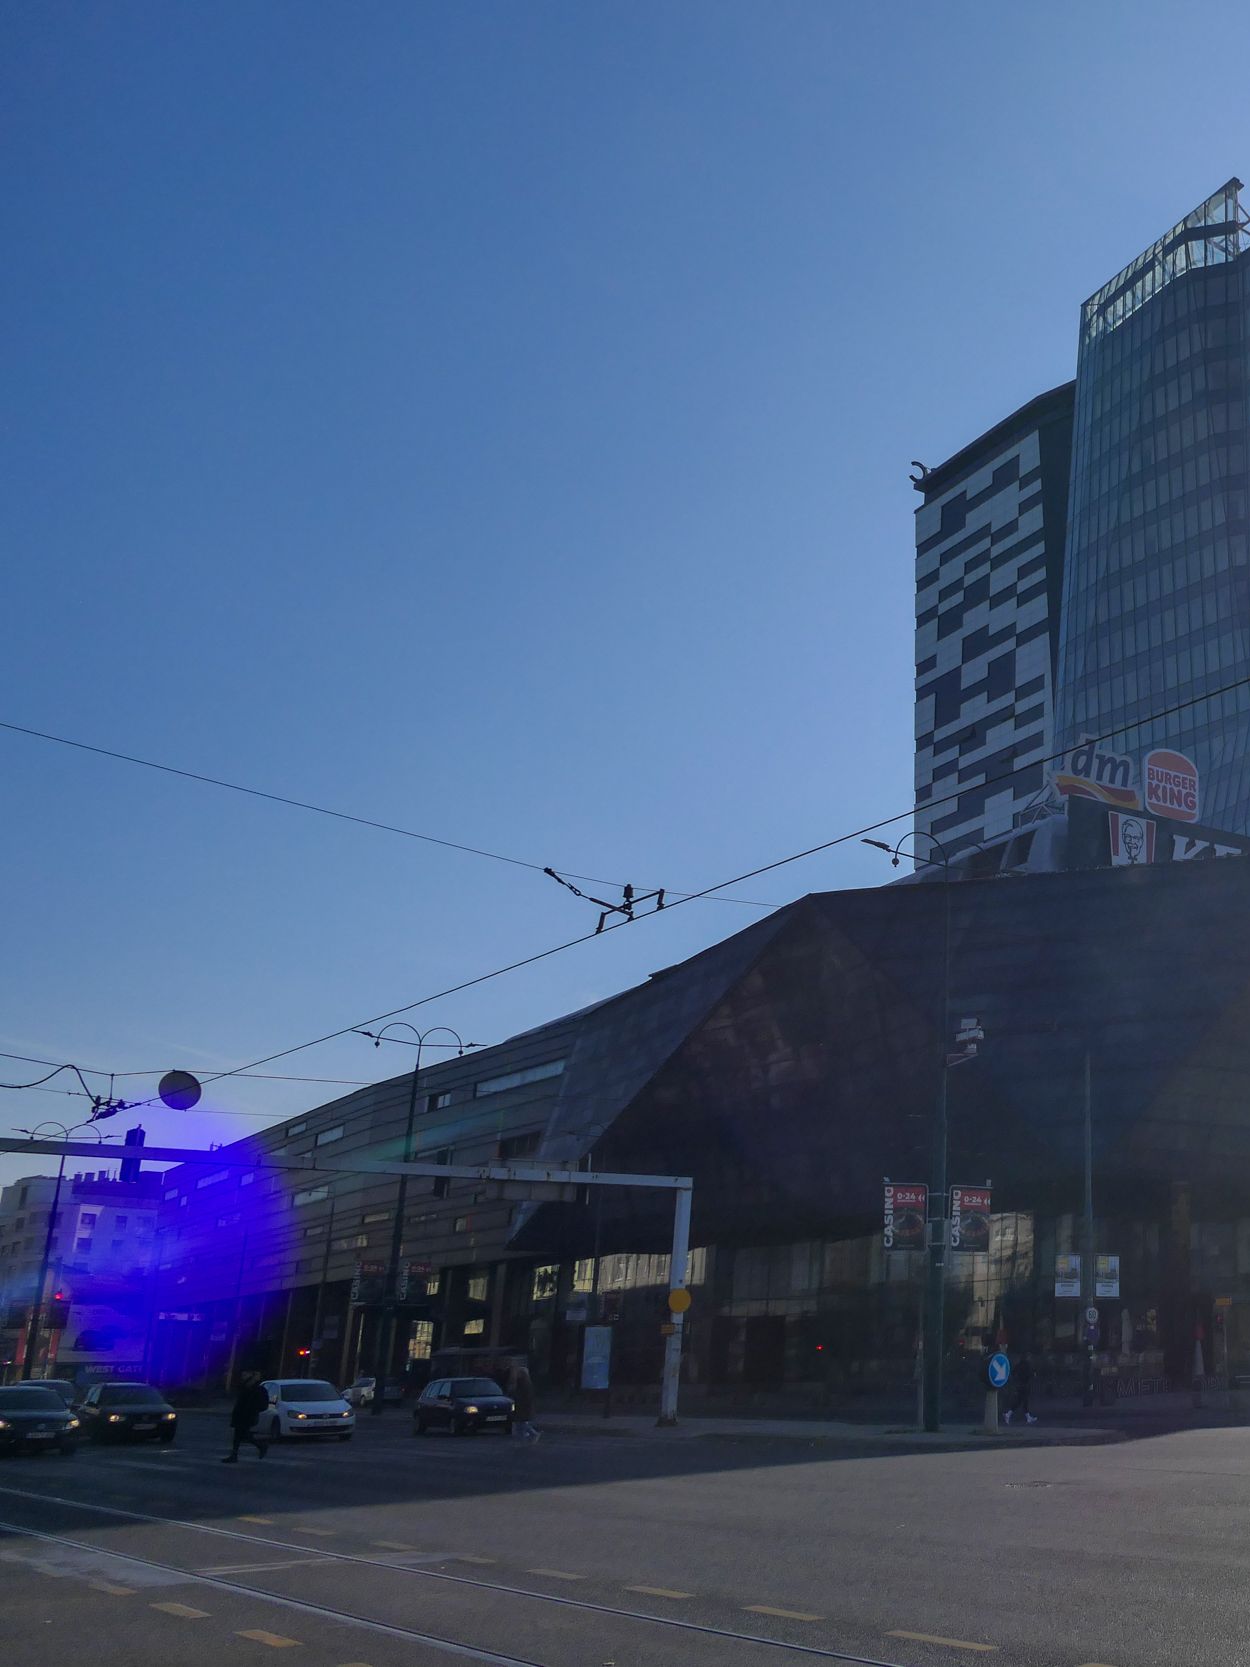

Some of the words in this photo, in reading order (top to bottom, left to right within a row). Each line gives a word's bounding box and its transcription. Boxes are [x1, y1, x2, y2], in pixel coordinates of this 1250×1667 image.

[1071, 738, 1131, 788] dm
[1148, 767, 1197, 793] BURGER
[1147, 782, 1197, 811] KING
[883, 1186, 894, 1248] CASINO
[951, 1189, 962, 1247] CASINO
